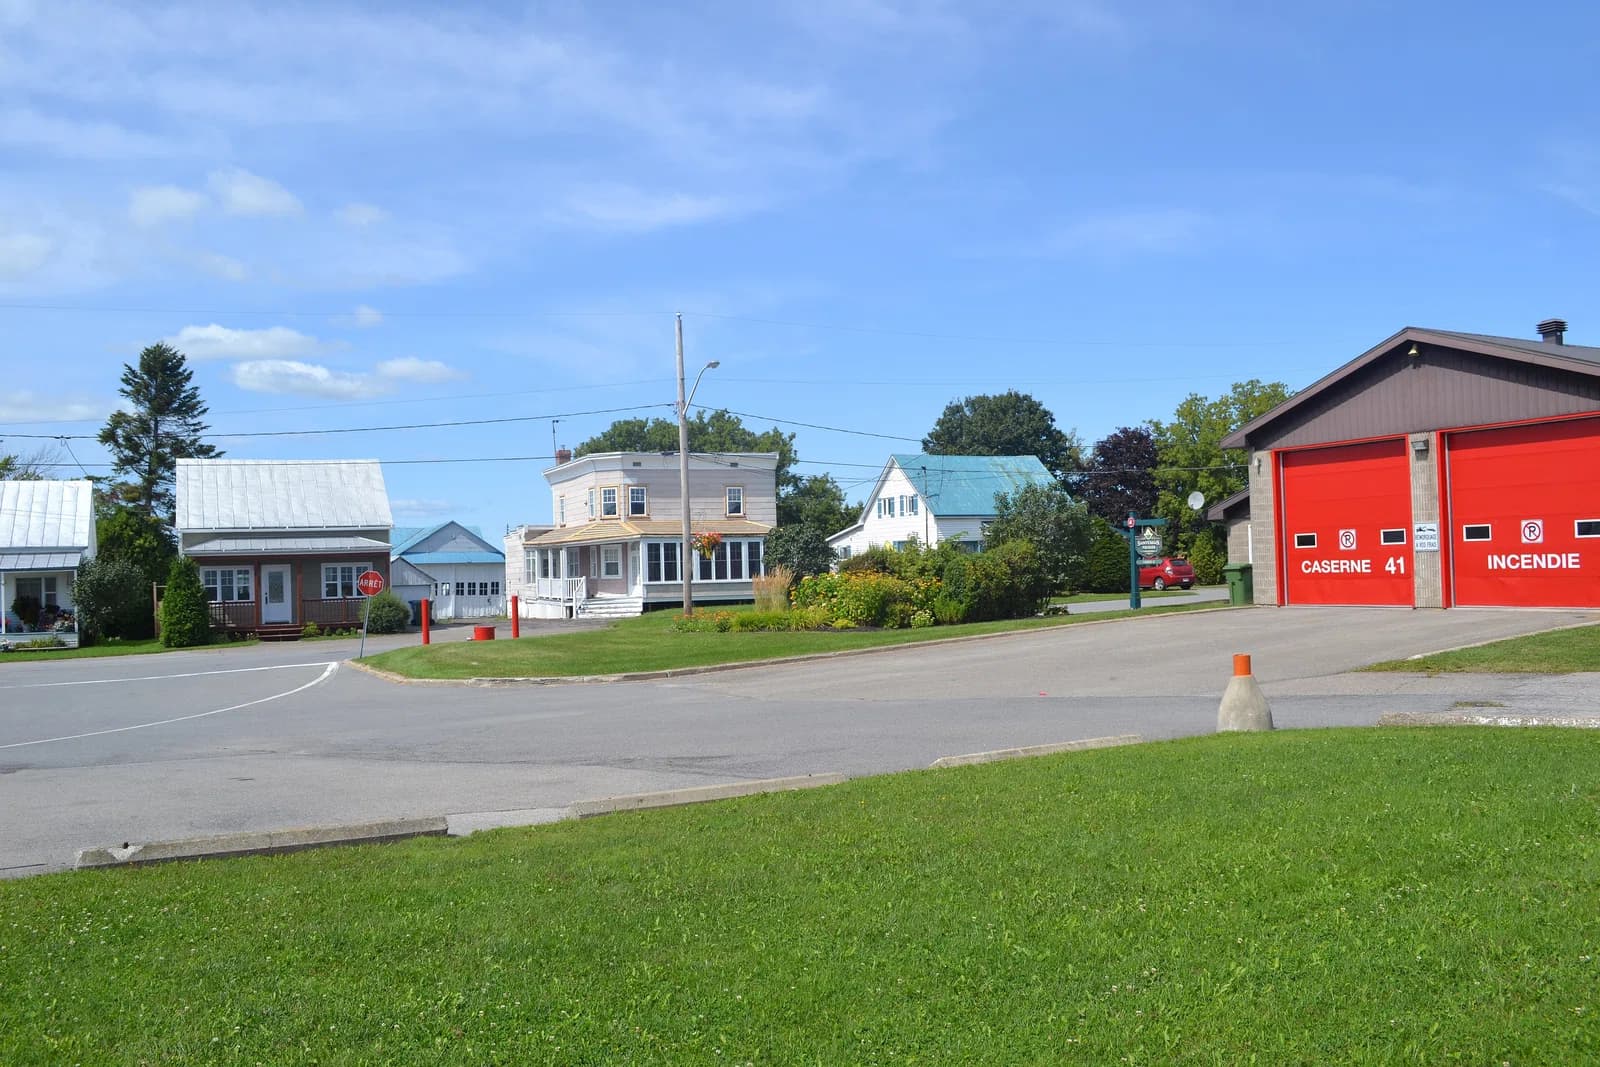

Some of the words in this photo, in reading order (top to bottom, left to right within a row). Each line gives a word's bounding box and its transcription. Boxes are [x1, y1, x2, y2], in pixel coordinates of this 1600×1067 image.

[1301, 559, 1372, 574] CASERNE
[1384, 556, 1405, 574] 41
[1487, 553, 1580, 570] INCENDIE
